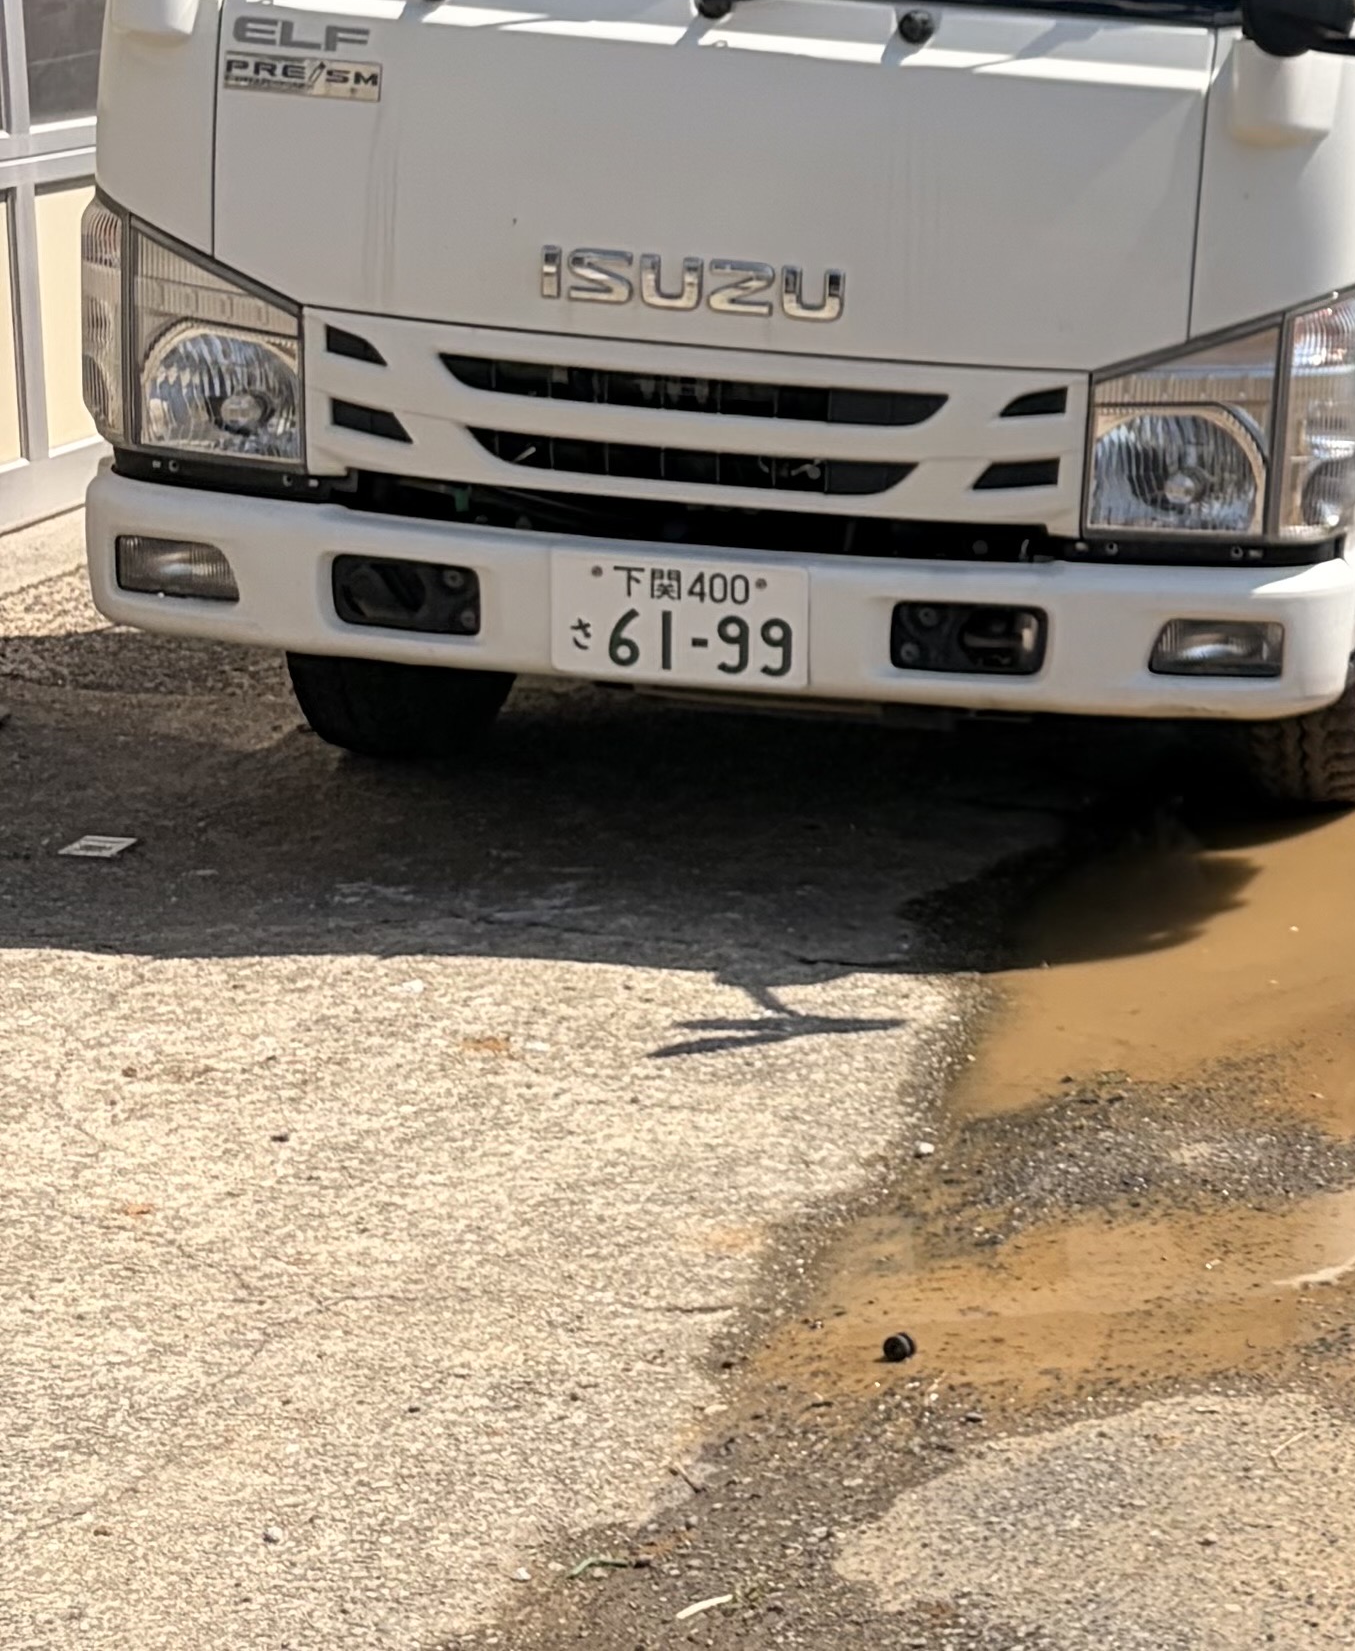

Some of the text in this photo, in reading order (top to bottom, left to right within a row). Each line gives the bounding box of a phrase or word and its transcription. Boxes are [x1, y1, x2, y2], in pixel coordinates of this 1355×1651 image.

[233, 15, 370, 51] ELF
[541, 244, 846, 322] ISUZU
[570, 608, 793, 677] さ 61-99
